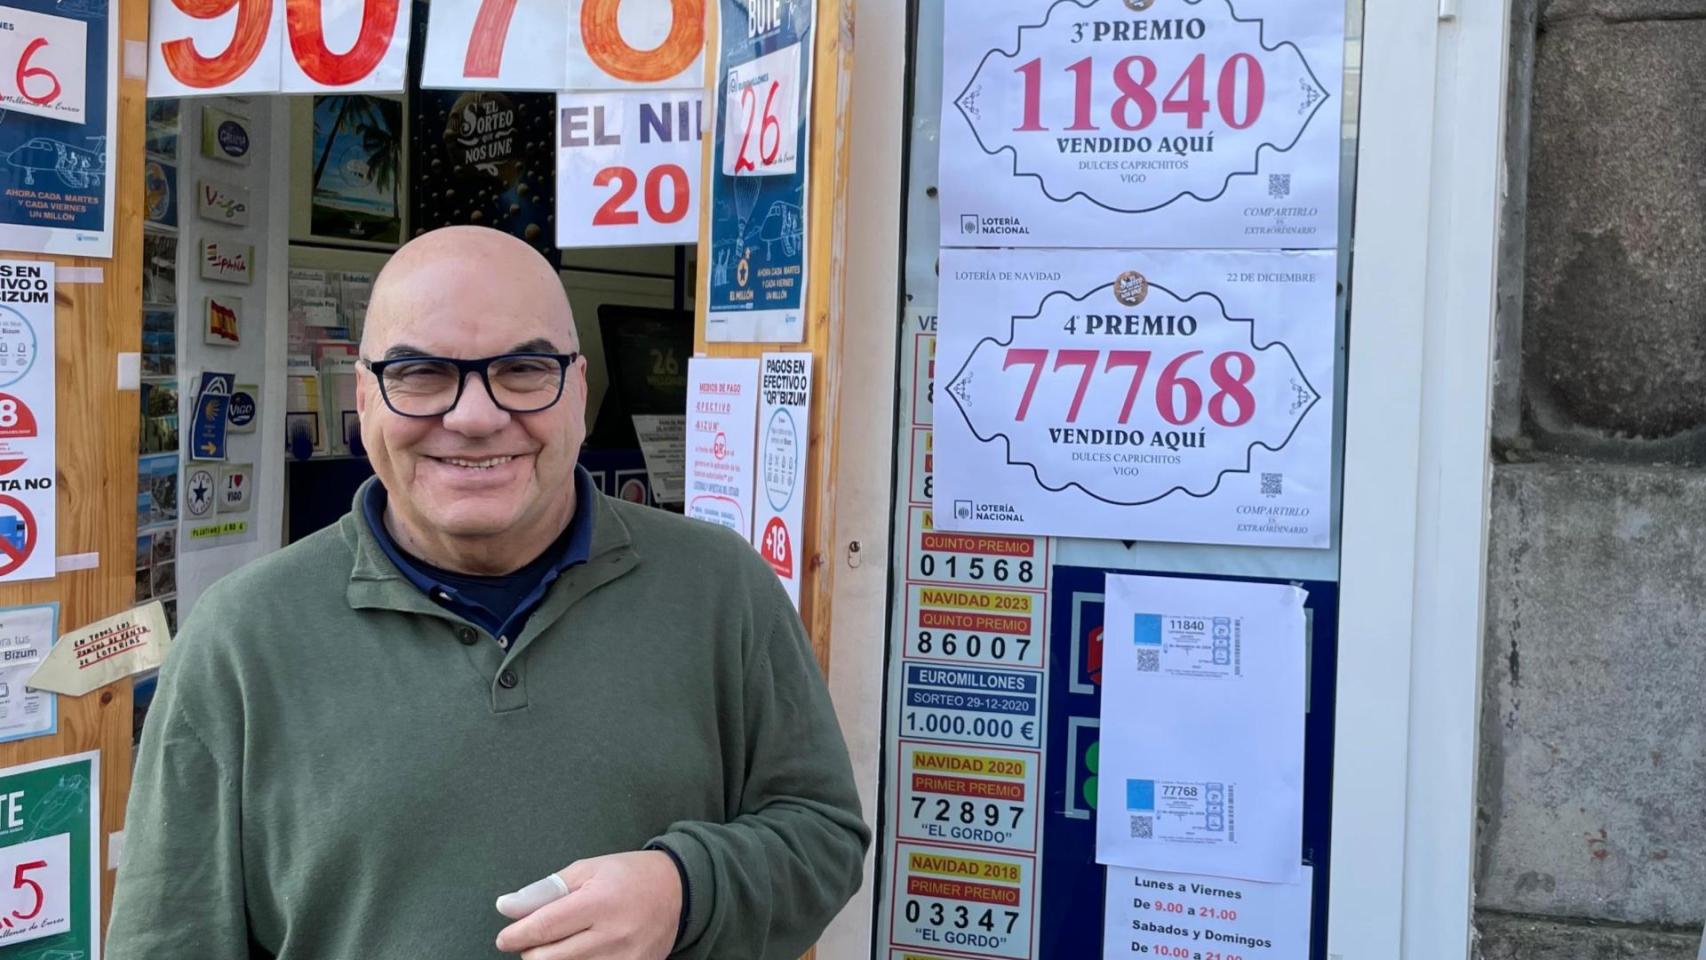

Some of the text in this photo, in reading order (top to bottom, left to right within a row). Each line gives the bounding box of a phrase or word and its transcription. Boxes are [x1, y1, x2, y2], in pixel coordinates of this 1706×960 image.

[1092, 18, 1206, 42] PREMIO
[1012, 52, 1266, 132] 11840
[461, 103, 513, 137] SORTEO
[560, 106, 620, 147] EL
[735, 80, 780, 175] 26
[465, 138, 512, 164] NOS UNE
[1057, 132, 1214, 156] VENDIDO AQUÍ
[1079, 160, 1188, 170] DULCES CAPRICHITOS
[1120, 174, 1146, 183] VIGO
[5, 189, 99, 204] AHORA CADA MARTES
[592, 164, 690, 226] 20
[25, 200, 48, 209] CADA
[51, 203, 86, 212] VIERNES
[1244, 207, 1318, 217] COMPARTIRLO
[982, 216, 1020, 226] LOTERÍA
[982, 226, 1030, 235] NACIONAL
[16, 266, 40, 278] EN
[955, 271, 1061, 281] LOTERÍA DE NAVIDAD
[1226, 273, 1316, 283] 22 DE DICIEMBRE
[34, 279, 48, 291] O
[0, 290, 49, 304] IZUM
[1085, 314, 1198, 336] PREMIO
[767, 360, 805, 374] PAGOS EN
[763, 375, 807, 390] EFECTIVO O
[1002, 348, 1256, 427] 77768
[780, 392, 807, 407] BIZUM
[1048, 428, 1206, 452] VENDIDO AQUÍ
[1072, 453, 1181, 464] DULCES CAPRICHITOS
[1113, 467, 1139, 477] VIGO
[24, 477, 52, 490] NO
[976, 504, 1015, 513] LOTERÍA
[976, 512, 1024, 522] NACIONAL
[1236, 505, 1310, 517] COMPARTIRLO
[766, 525, 786, 562] +18
[924, 536, 1030, 554] QUINTO PREMIO
[922, 591, 1029, 611] NAVIDAD 2023
[923, 614, 1028, 632] QUINTO PREMIO
[1170, 619, 1205, 631] 11840
[4, 649, 38, 661] Bizum
[919, 669, 1025, 690] EUROMILLONES
[913, 692, 1030, 712] SORTEO 29-12-2020
[907, 712, 1035, 740] 1.000.000 €
[915, 754, 1023, 776] NAVIDAD 2020
[916, 778, 1021, 798] PRIMER PREMIO
[1162, 785, 1198, 797] 77768
[911, 856, 1019, 880] NAVIDAD 2018
[911, 880, 1017, 903] PRIMER PREMIO
[1135, 876, 1242, 900] Lunes a Viernes
[1133, 898, 1237, 921] De 9.00 a 21.00
[29, 922, 38, 931] de
[41, 918, 64, 928] Euros
[1132, 919, 1272, 949] Sabados y Domingos
[1131, 941, 1149, 953] De
[1153, 944, 1189, 958] 10.00
[1193, 951, 1201, 960] a
